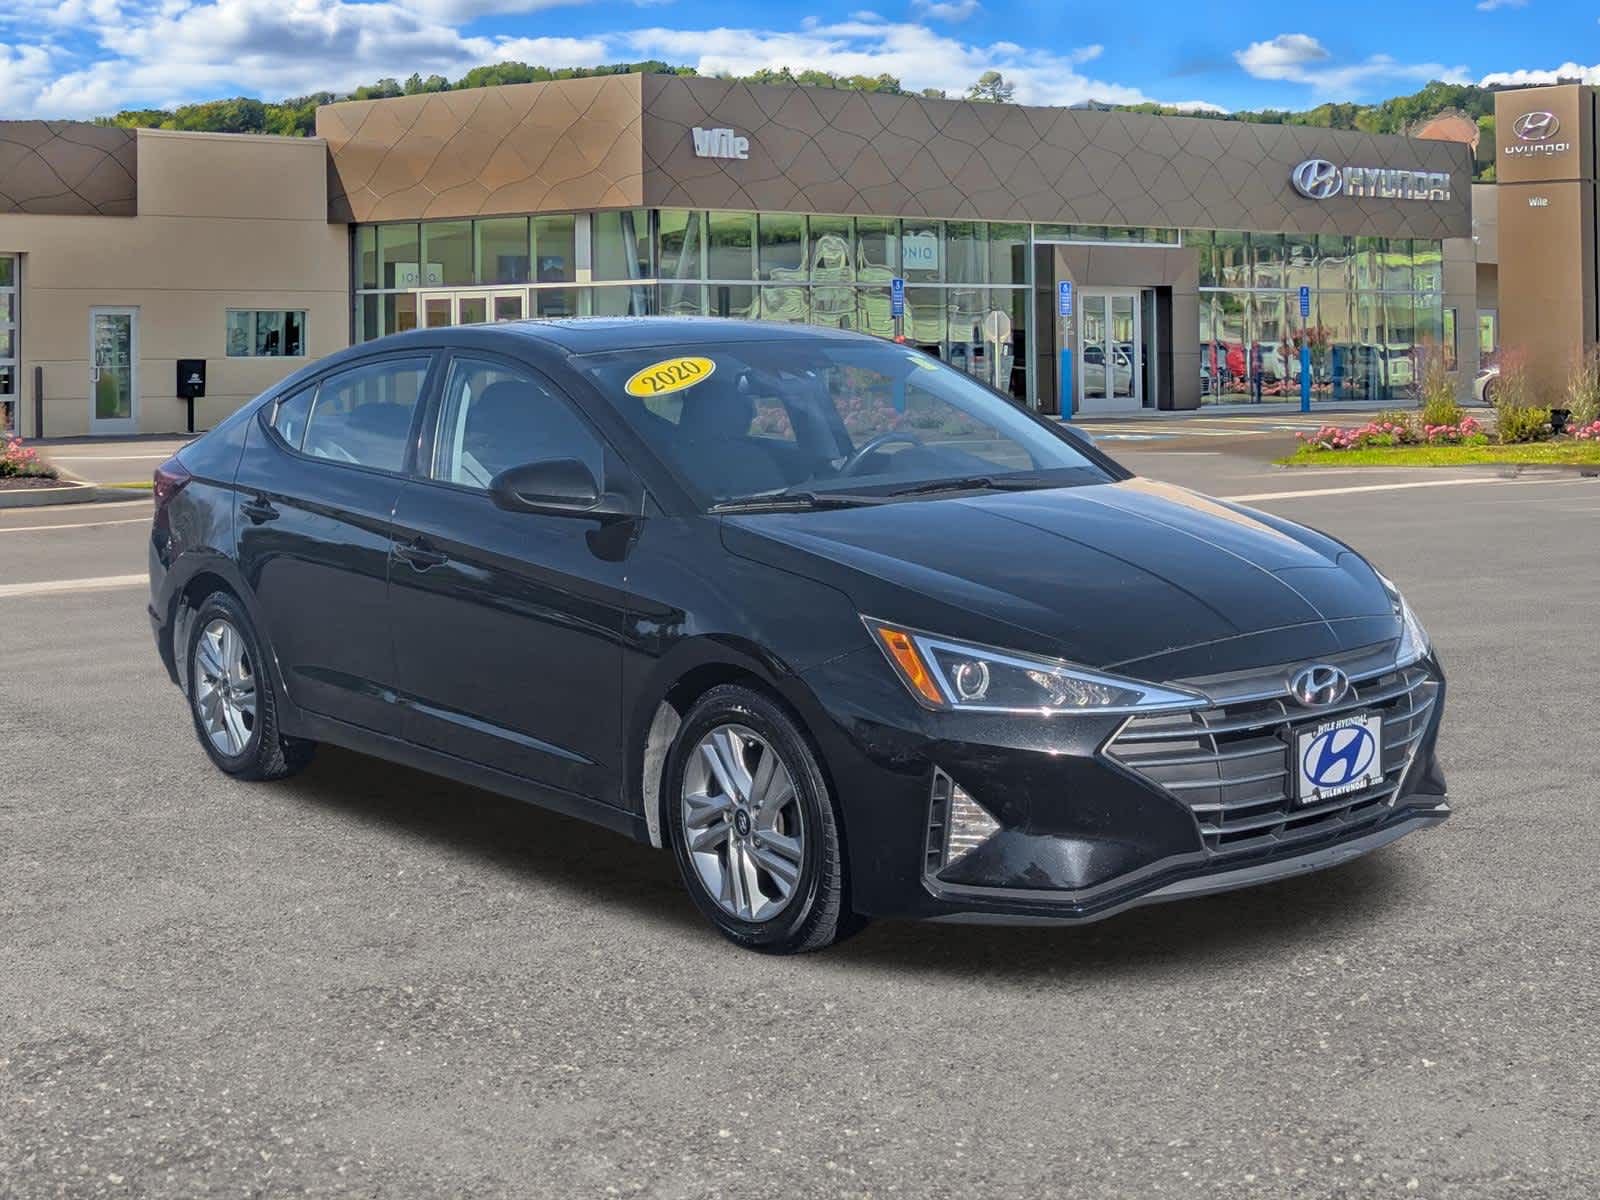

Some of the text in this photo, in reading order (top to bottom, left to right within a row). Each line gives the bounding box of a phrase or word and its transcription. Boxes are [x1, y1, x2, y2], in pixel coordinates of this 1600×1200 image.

[692, 127, 749, 160] Wile
[1343, 167, 1451, 201] HYUNDAI
[1528, 197, 1549, 207] Wile
[641, 360, 701, 393] 2020
